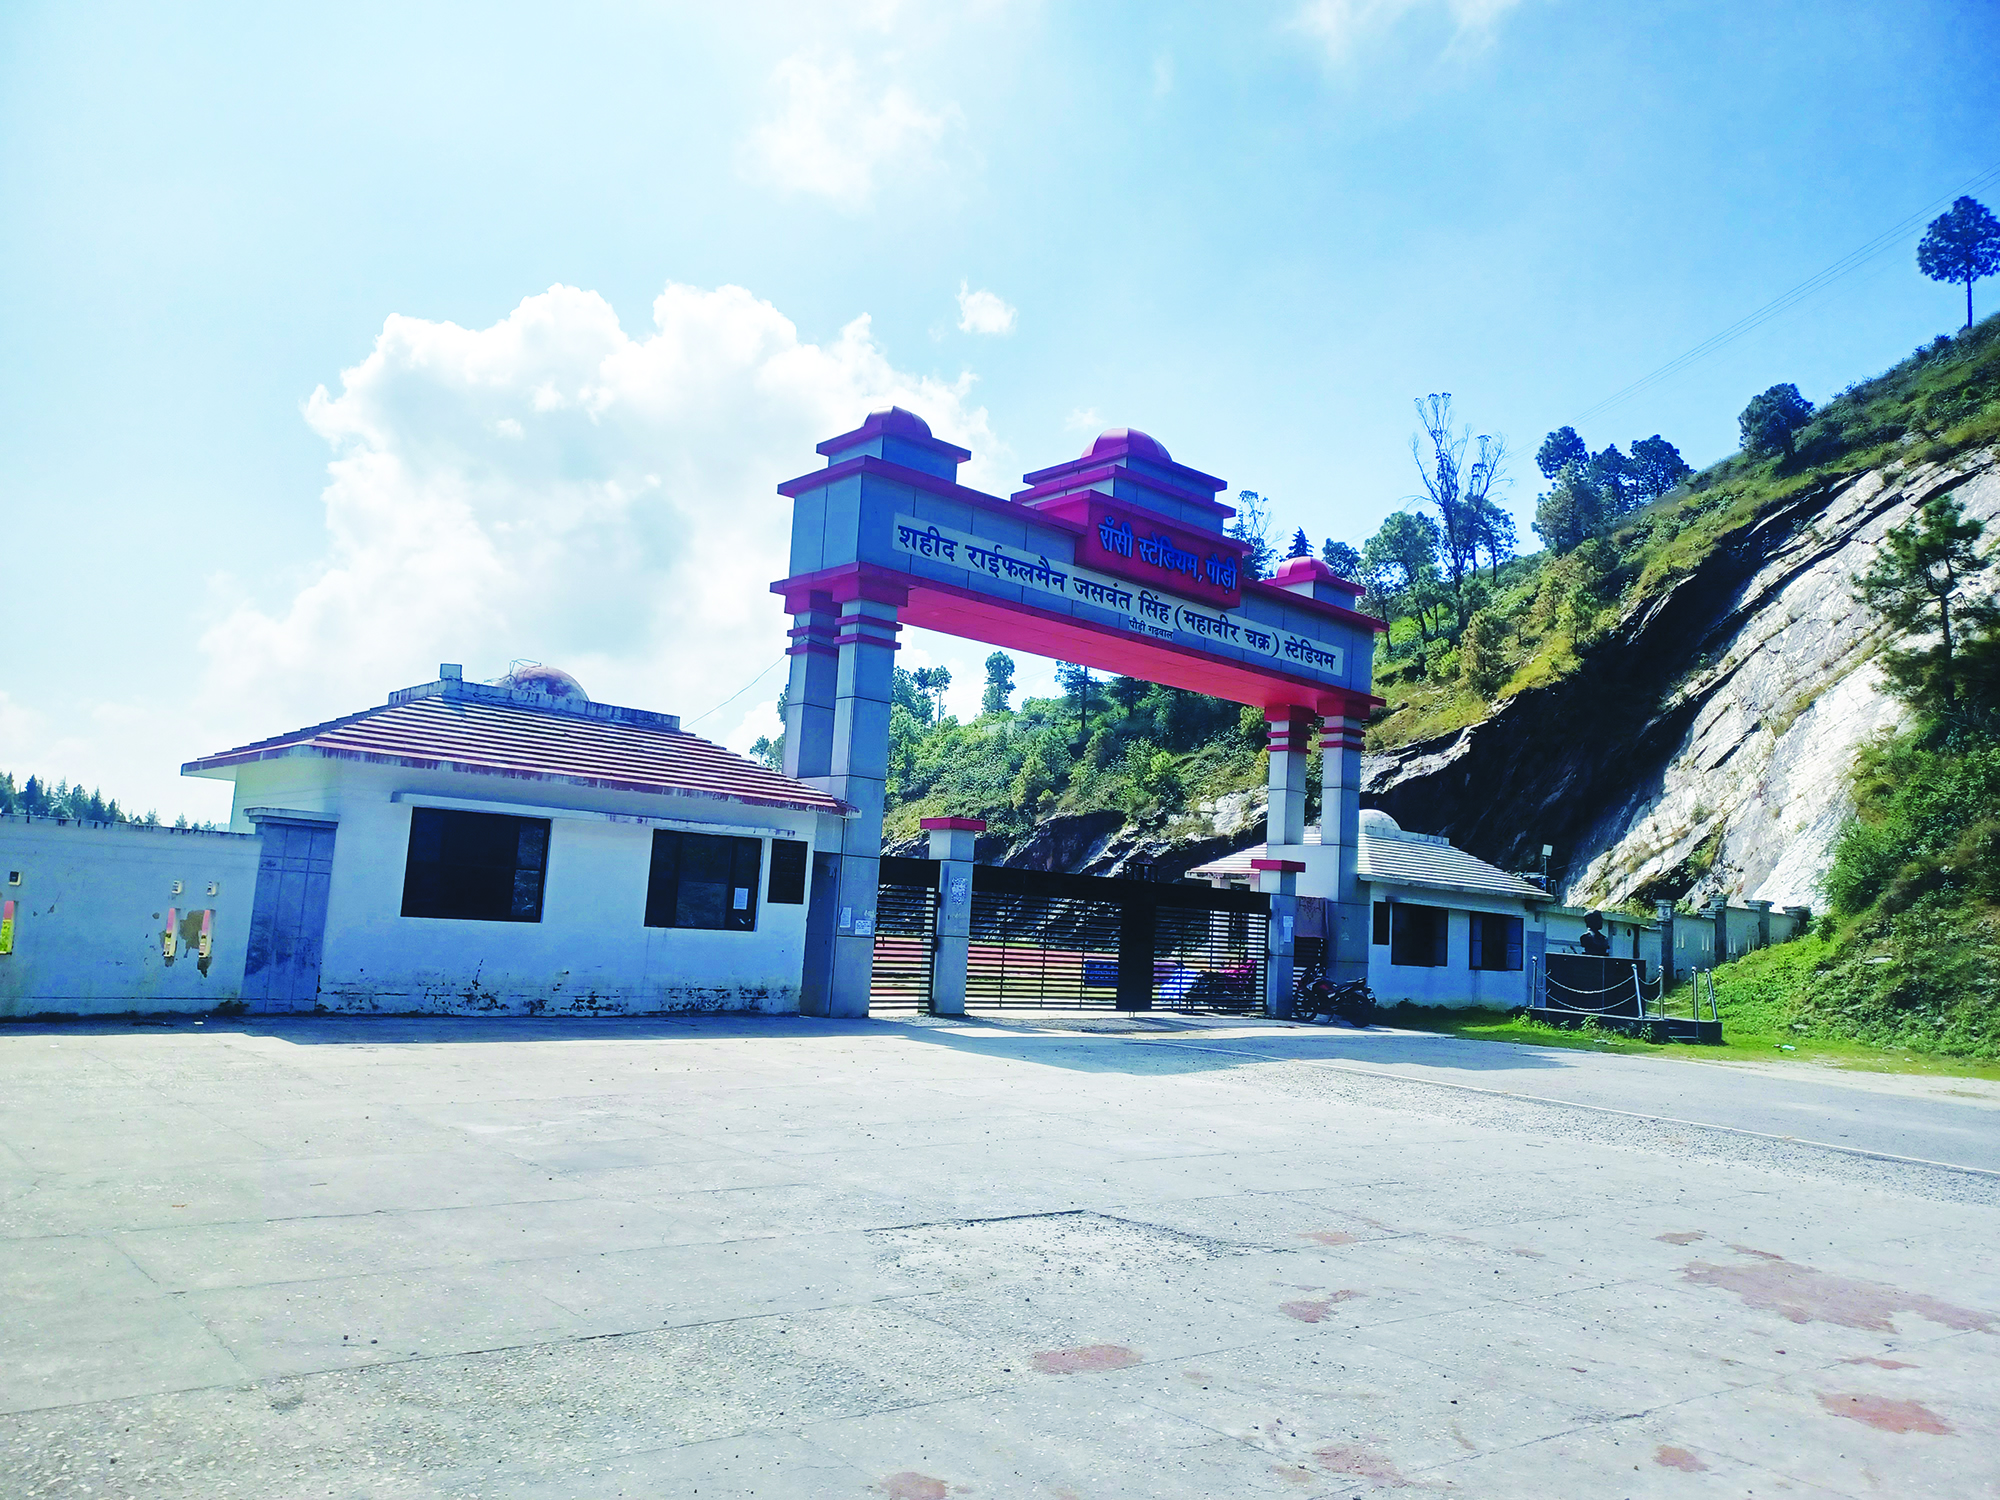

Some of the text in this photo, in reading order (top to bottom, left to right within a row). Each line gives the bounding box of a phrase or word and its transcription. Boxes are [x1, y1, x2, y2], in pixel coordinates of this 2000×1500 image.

[897, 525, 1336, 670] शहीद राईफलमैन जसवंत सिंह (महावीर चक्र) स्टेडियम
[1098, 515, 1134, 558] राँसी
[1205, 553, 1238, 594] पौड़ी
